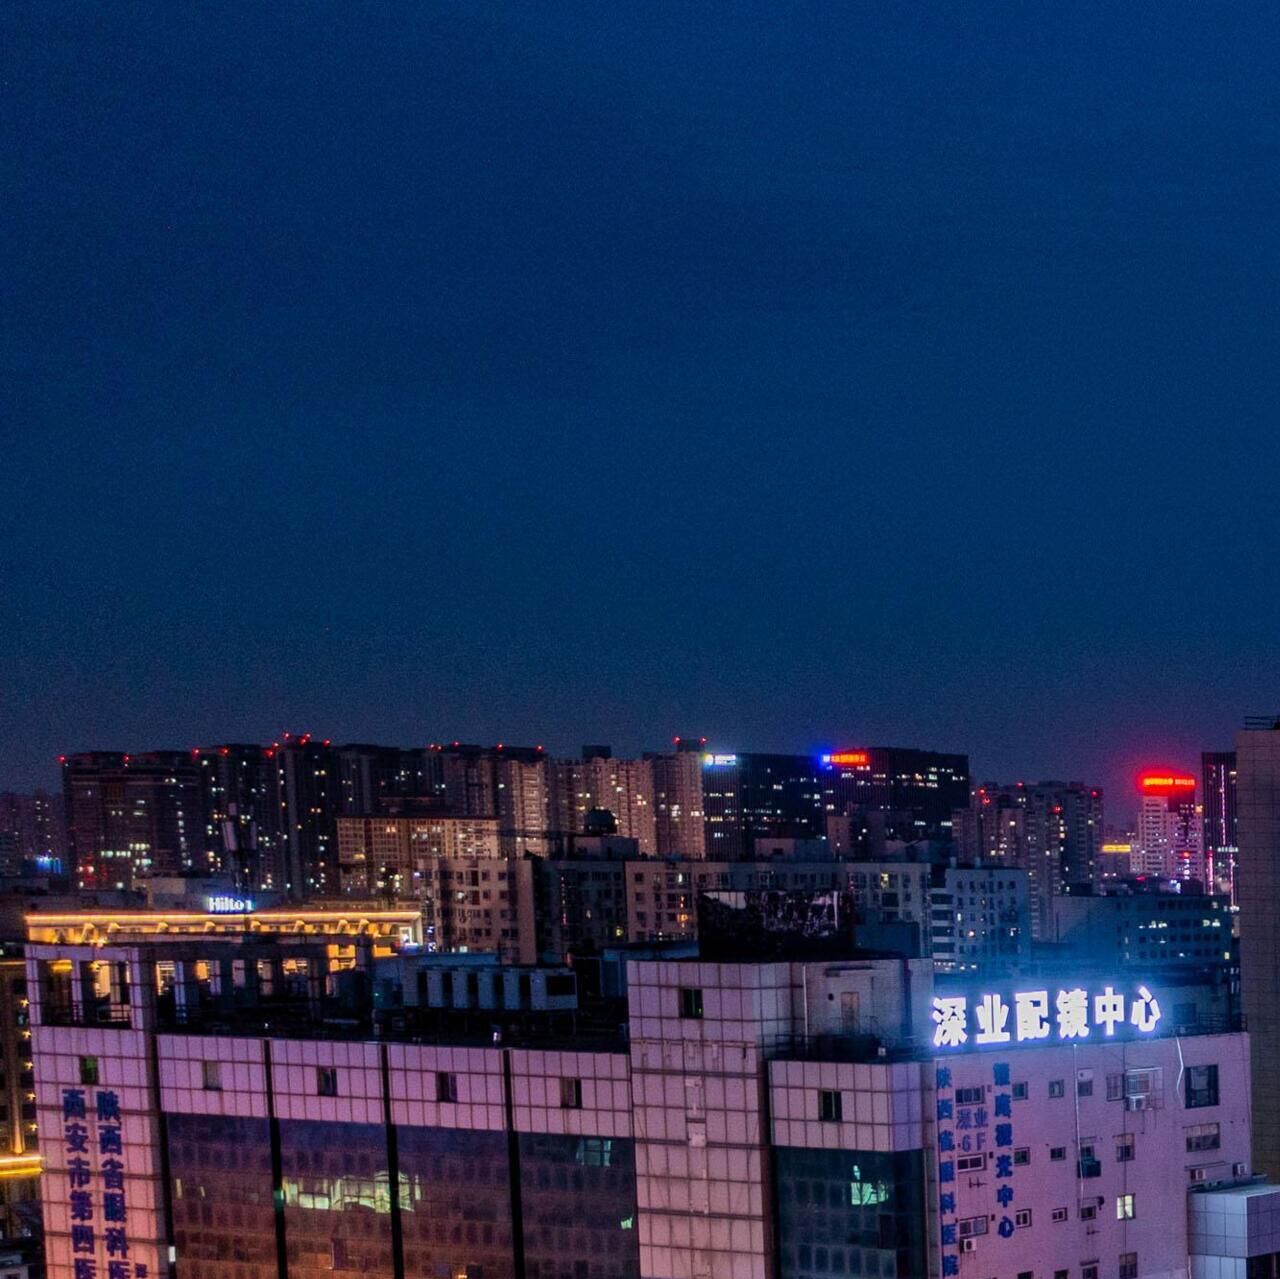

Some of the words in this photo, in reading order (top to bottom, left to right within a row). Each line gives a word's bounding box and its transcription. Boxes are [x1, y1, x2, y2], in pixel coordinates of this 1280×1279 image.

[932, 986, 1161, 1047] 深业配镜中心
